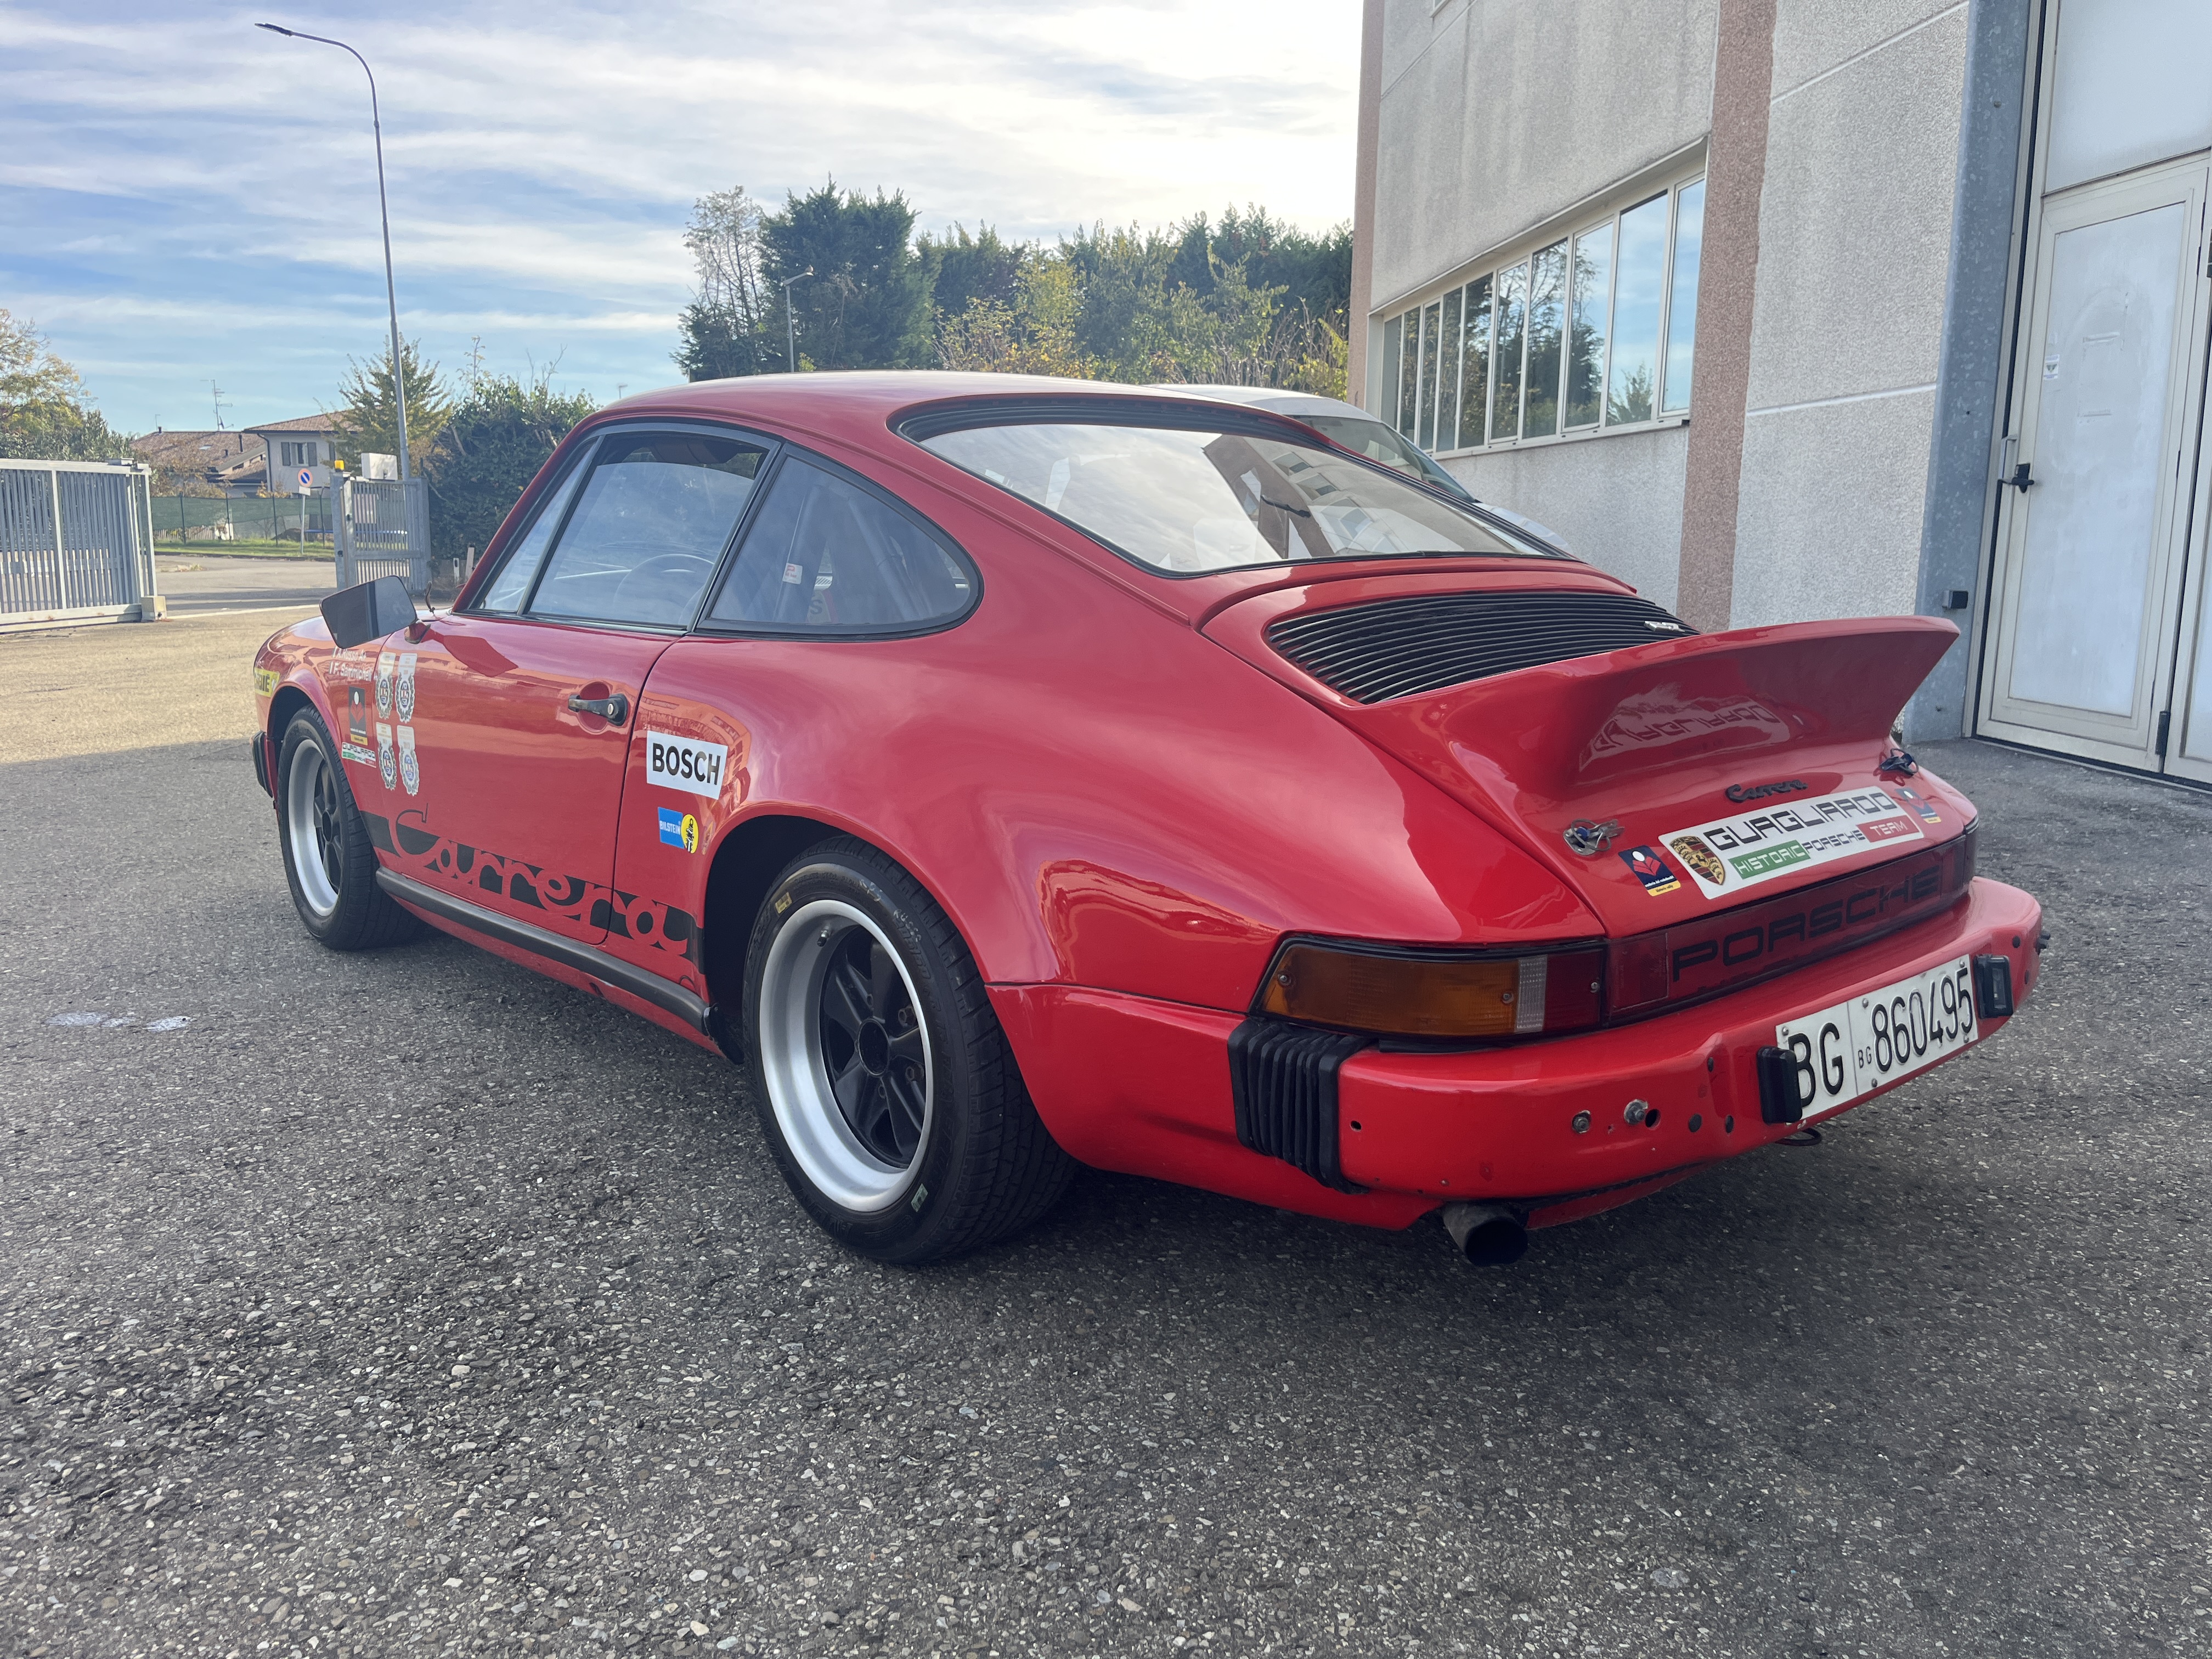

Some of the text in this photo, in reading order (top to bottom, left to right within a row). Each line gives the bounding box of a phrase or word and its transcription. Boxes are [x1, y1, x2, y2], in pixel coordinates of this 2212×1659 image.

[653, 743, 720, 785] BOSCH
[1725, 779, 1808, 803] Carrera
[660, 821, 681, 835] BILSTEIN
[1703, 792, 1898, 851] GUAGLIARDO
[1735, 820, 1909, 874] HISTORIC PORSCHE TEAM
[387, 803, 688, 956] Carrera
[1673, 865, 1940, 982] PORSCHE
[1788, 967, 1973, 1107] BG BG 860495
